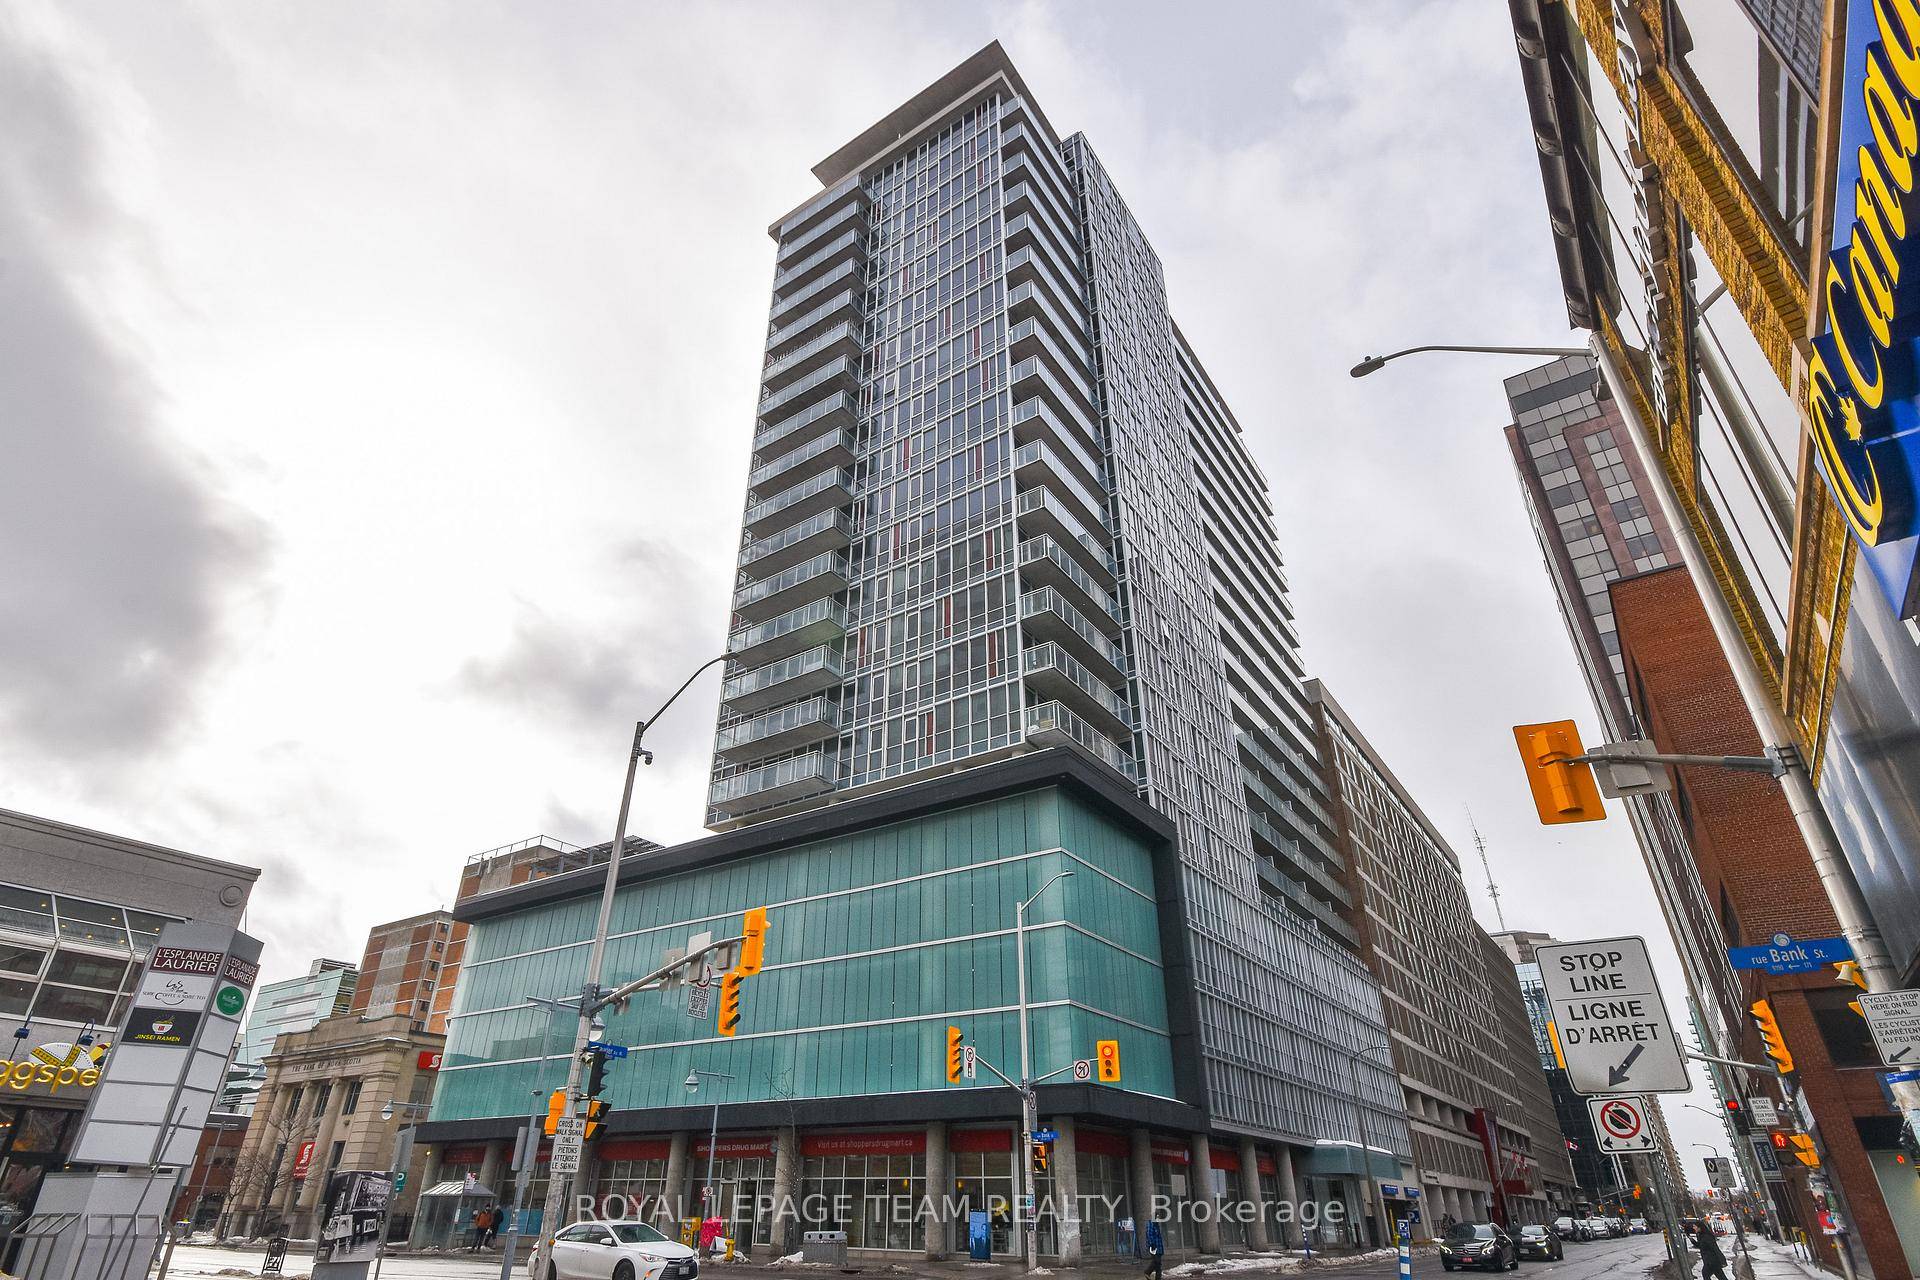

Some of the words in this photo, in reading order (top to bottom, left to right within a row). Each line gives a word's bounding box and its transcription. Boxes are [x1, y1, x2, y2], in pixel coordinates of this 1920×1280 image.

[156, 948, 221, 963] L'ESPLANADE
[1751, 955, 1768, 965] rue
[1769, 945, 1809, 963] Bank
[1813, 948, 1829, 959] St.
[153, 958, 218, 972] LAURIER
[227, 956, 257, 976] L'ESPLANADE
[1559, 951, 1623, 972] STOP
[224, 966, 254, 985] LAURIER
[1569, 973, 1626, 993] LINE
[1863, 995, 1899, 1004] CYCLISTS
[1899, 993, 1919, 1001] STOP
[1567, 1000, 1646, 1021] LIGNE
[1870, 1003, 1890, 1011] HERE
[1891, 1001, 1902, 1009] ON
[1903, 1000, 1918, 1008] RED
[1883, 1009, 1911, 1017] SIGNAL
[1874, 1022, 1889, 1030] LES
[157, 1034, 181, 1042] RAMEN
[1565, 1022, 1659, 1045] D'ARRÊT
[1894, 1035, 1910, 1043] FEU
[326, 1060, 340, 1068] NOVA
[343, 1057, 361, 1066] SCOTIA
[559, 1120, 574, 1128] CROSS
[561, 1136, 575, 1144] ONLY
[554, 1154, 578, 1163] ATTENDEZ
[560, 1162, 577, 1170] SIGNAL
